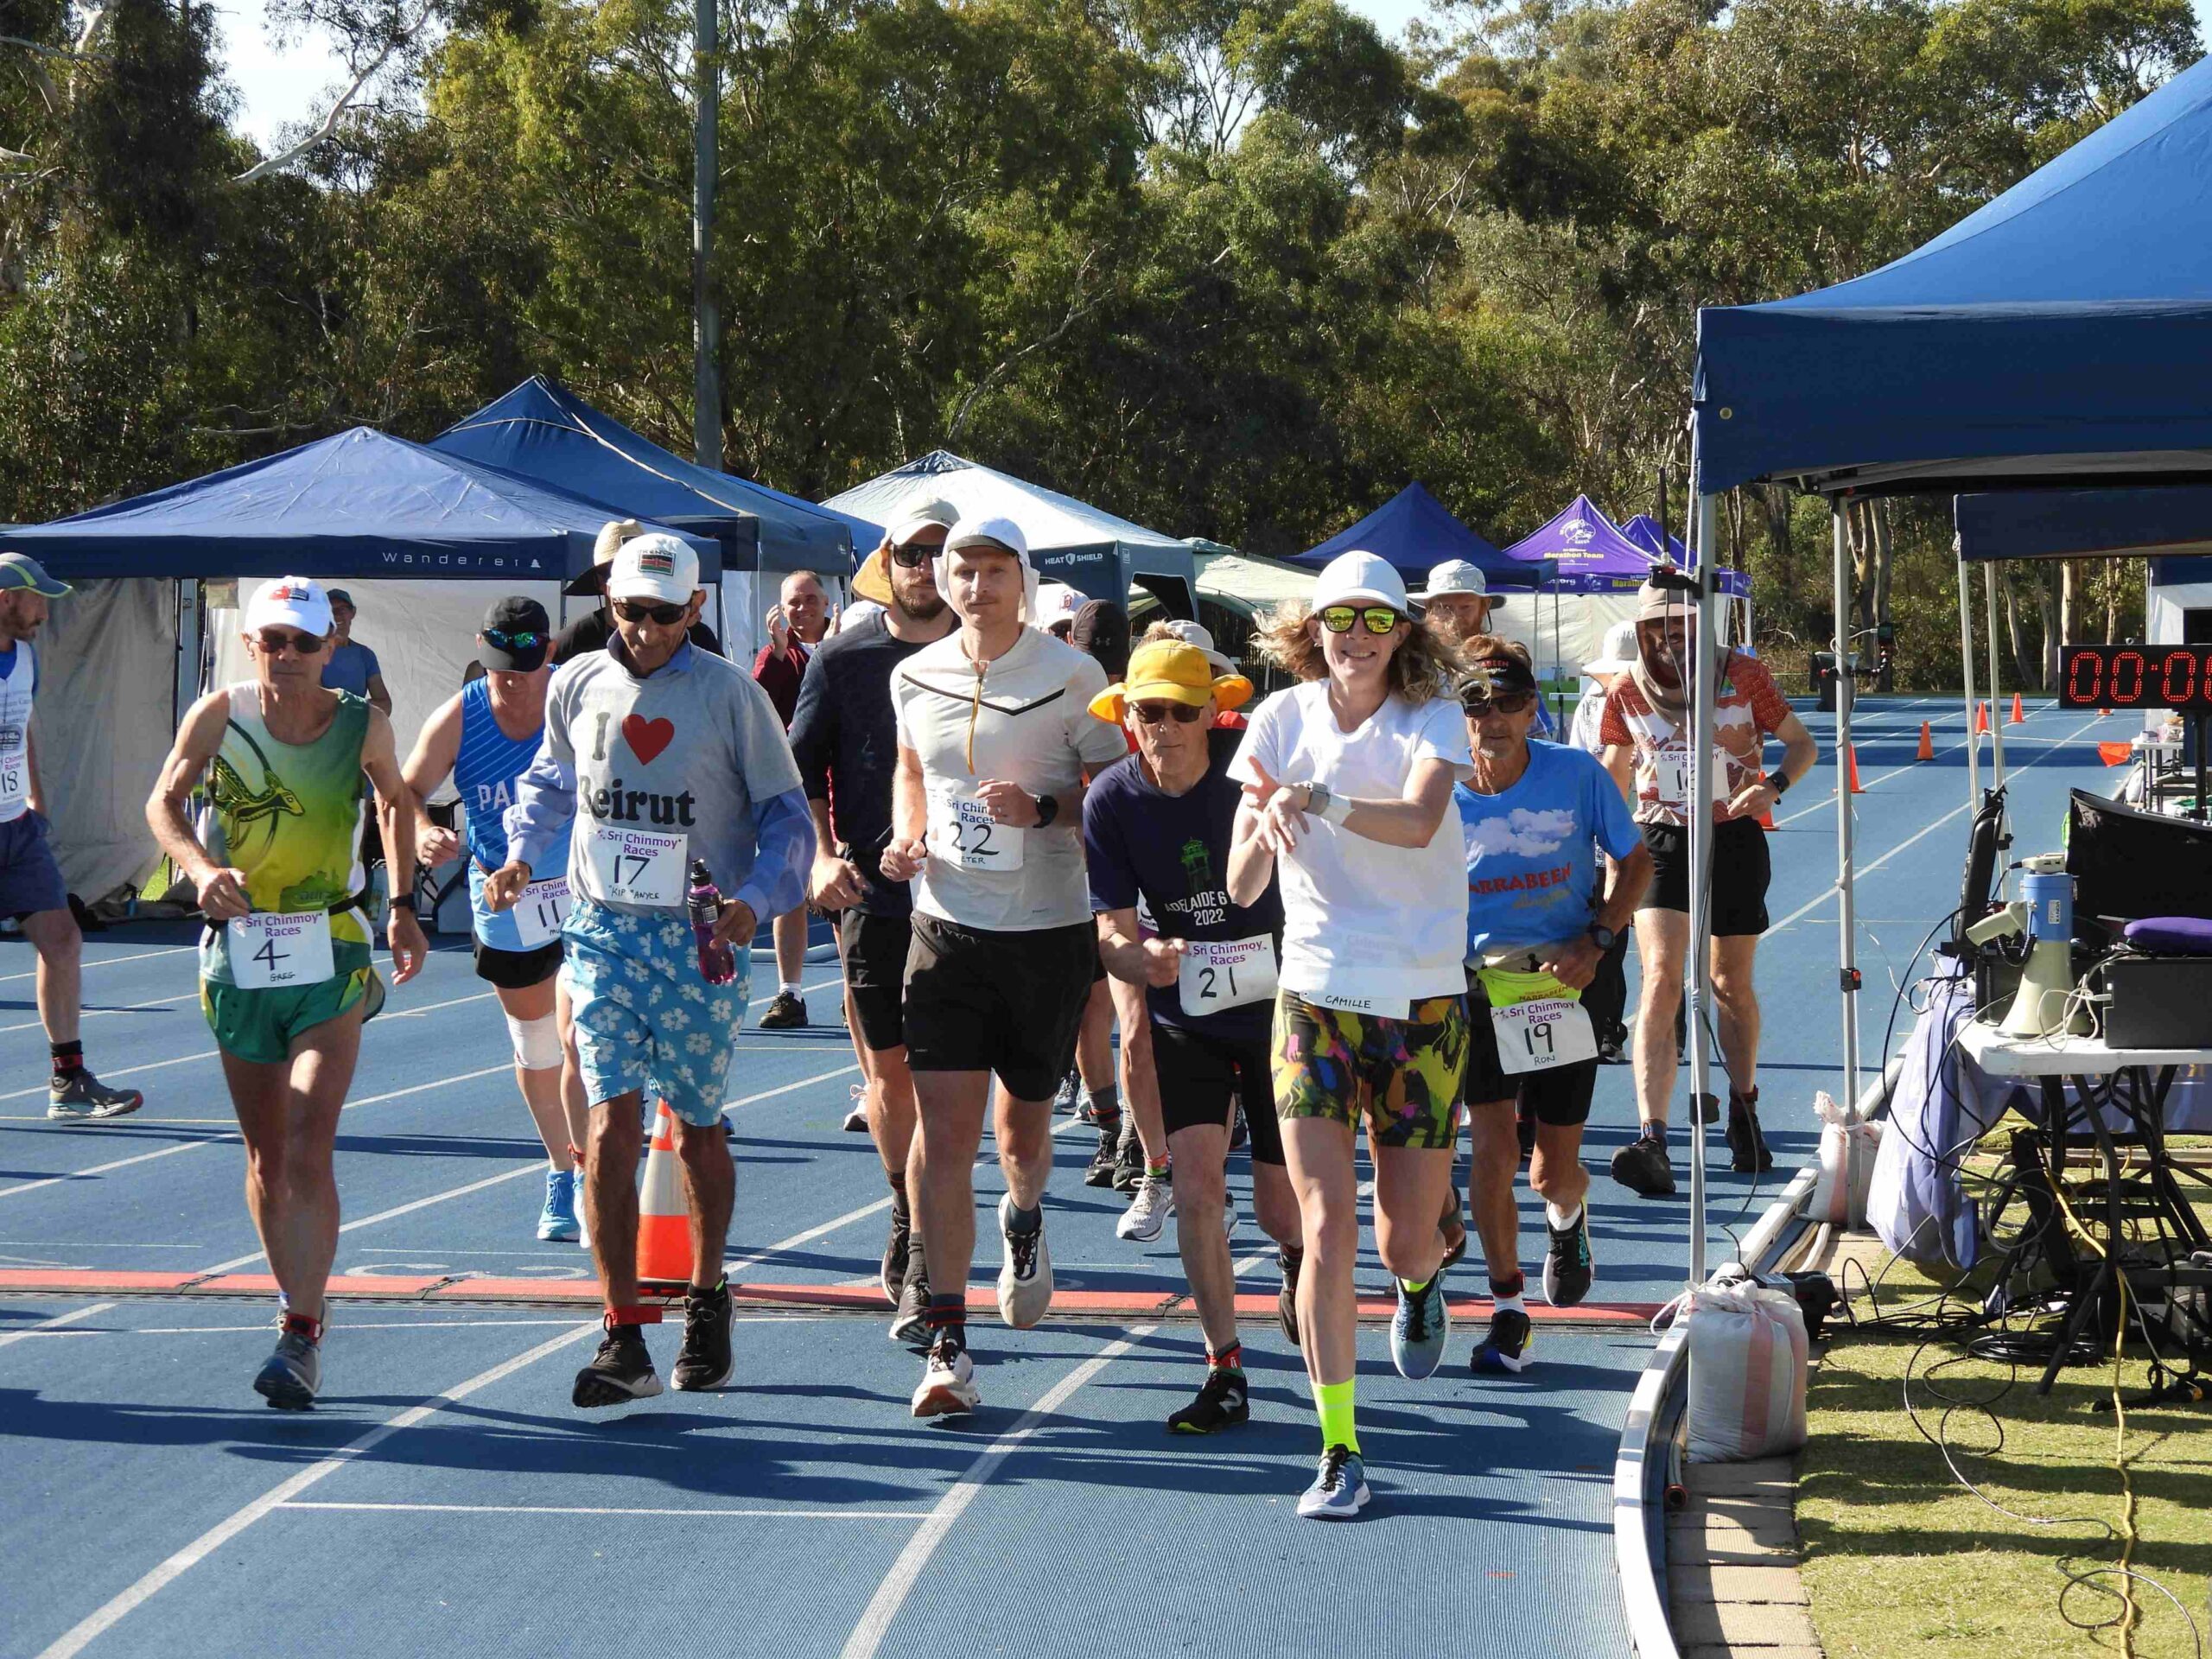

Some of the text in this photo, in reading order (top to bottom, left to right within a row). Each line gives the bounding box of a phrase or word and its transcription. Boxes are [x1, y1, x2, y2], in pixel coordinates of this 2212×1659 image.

[383, 552, 518, 567] Wanderer
[1045, 553, 1103, 565] HEAT SHIELD
[593, 712, 611, 760] I
[2, 771, 18, 794] 18
[580, 775, 696, 827] Beirut
[947, 798, 959, 810] Sri
[961, 812, 995, 825] Races
[607, 830, 677, 850] Sri Chinmoy
[950, 821, 1000, 855] 22
[623, 843, 658, 856] Races
[613, 854, 651, 886] 17
[525, 885, 540, 896] Sri
[542, 888, 570, 900] Races
[1165, 890, 1228, 913] ADELAIDE 6
[245, 913, 318, 928] Sri Chinmoy
[537, 899, 561, 928] 11
[1194, 908, 1226, 926] 2022
[265, 926, 302, 938] Races
[252, 938, 291, 971] 4
[1192, 940, 1262, 956] Sri Chinmoy
[1210, 954, 1246, 966] Races
[1198, 966, 1237, 998] 21
[1325, 995, 1371, 1008] CAMILLE
[1510, 1001, 1575, 1018] Sri Chinmoy
[1529, 1011, 1562, 1025] Races
[1524, 1022, 1554, 1055] 19
[1534, 1055, 1556, 1065] RON
